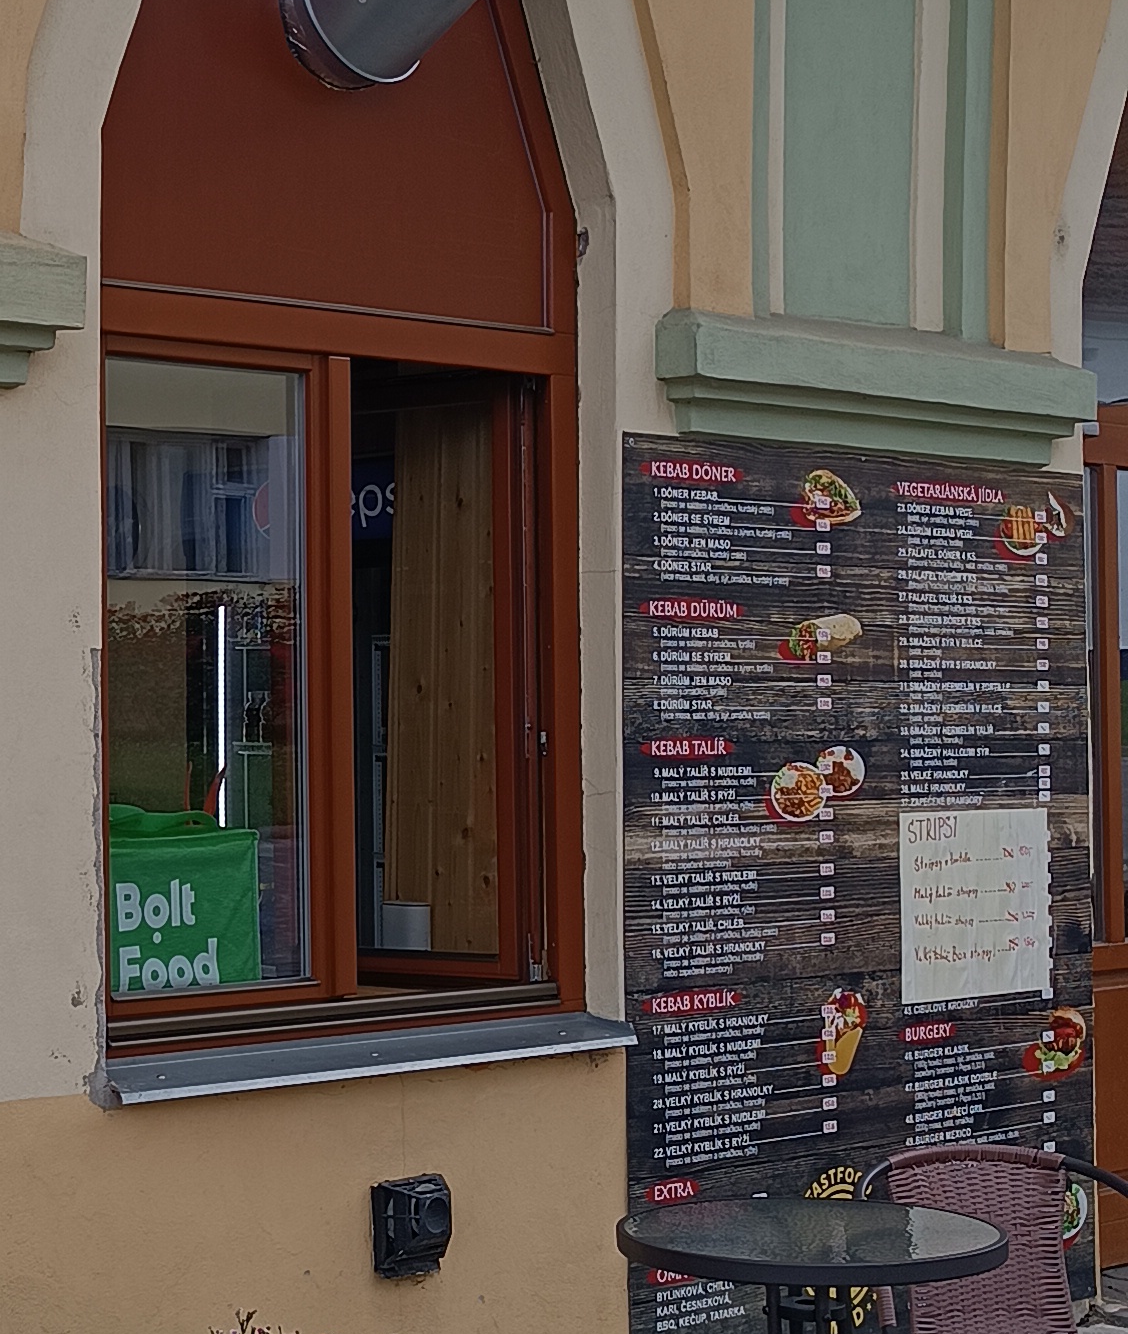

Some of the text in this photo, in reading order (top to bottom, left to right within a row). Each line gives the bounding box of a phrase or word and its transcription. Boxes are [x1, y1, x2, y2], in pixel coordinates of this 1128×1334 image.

[651, 462, 736, 482] KEBAB DÖNER
[661, 488, 689, 499] DÖNER
[691, 491, 718, 501] KEBAB
[897, 482, 1003, 503] VEGETARIÁNSKÁ JÍDLA
[661, 512, 689, 523] DÖNER
[691, 515, 701, 524] SE
[661, 536, 731, 549] DÖNER JEN MASO
[661, 561, 712, 571] DÖNER STAR
[649, 601, 737, 617] KEBAB DÜRÜM
[691, 628, 718, 637] KEBAB
[692, 652, 702, 661] SE
[692, 676, 707, 685] JEN
[708, 676, 731, 685] MASO
[692, 701, 712, 709] STAR
[652, 738, 726, 755] KEBAB TALÍŘ
[662, 766, 684, 777] MALÝ
[687, 765, 708, 777] TALÍŘ
[711, 767, 715, 776] S
[718, 767, 751, 776] NUDLEMI
[662, 791, 684, 801] MALÝ
[687, 789, 708, 801] TALÍŘ
[711, 791, 716, 800] S
[908, 816, 957, 843] STRIPSY
[711, 839, 716, 848] S
[718, 837, 760, 847] HRANOLKY
[691, 871, 713, 883] TALÍŘ
[715, 872, 720, 881] S
[116, 879, 195, 932] Bolt
[663, 898, 689, 908] VELKÝ
[691, 895, 713, 907] TALÍŘ
[716, 896, 721, 906] S
[663, 922, 689, 932] VELKÝ
[718, 918, 744, 929] CHLÉB
[664, 947, 690, 957] VELKÝ
[692, 943, 714, 956] TALÍŘ
[716, 945, 721, 954] S
[723, 941, 765, 953] HRANOLKY
[119, 938, 219, 992] Food
[652, 989, 735, 1013] KEBAB KYBLÍK
[664, 1021, 686, 1033] MALÝ
[689, 1018, 717, 1032] KYBLÍK
[719, 1019, 724, 1028] S
[726, 1014, 769, 1027] HRANOLKY
[905, 1023, 951, 1041] BURGERY
[665, 1046, 687, 1058] MALÝ
[689, 1043, 717, 1055] KYBLÍK
[720, 1043, 724, 1053] S
[727, 1039, 760, 1052] NUDLEMI
[914, 1048, 943, 1059] BURGER
[665, 1071, 687, 1082] MALÝ
[689, 1067, 718, 1080] KYBLÍK
[720, 1067, 725, 1077] S
[914, 1079, 943, 1091] BURGER
[665, 1086, 773, 1107] VELKÝ KYBLÍK S HRANOLKY
[666, 1119, 691, 1132] VELKÝ
[694, 1115, 722, 1129] KYBLÍK
[724, 1115, 729, 1125] S
[732, 1110, 765, 1123] NUDLEMI
[915, 1110, 942, 1122] BURGER
[916, 1132, 944, 1145] BURGER
[666, 1143, 691, 1156] VELKÝ
[694, 1139, 722, 1153] KYBLÍK
[725, 1138, 730, 1148] S
[654, 1182, 693, 1200] EXTRA
[710, 1306, 745, 1321] TATARKA
